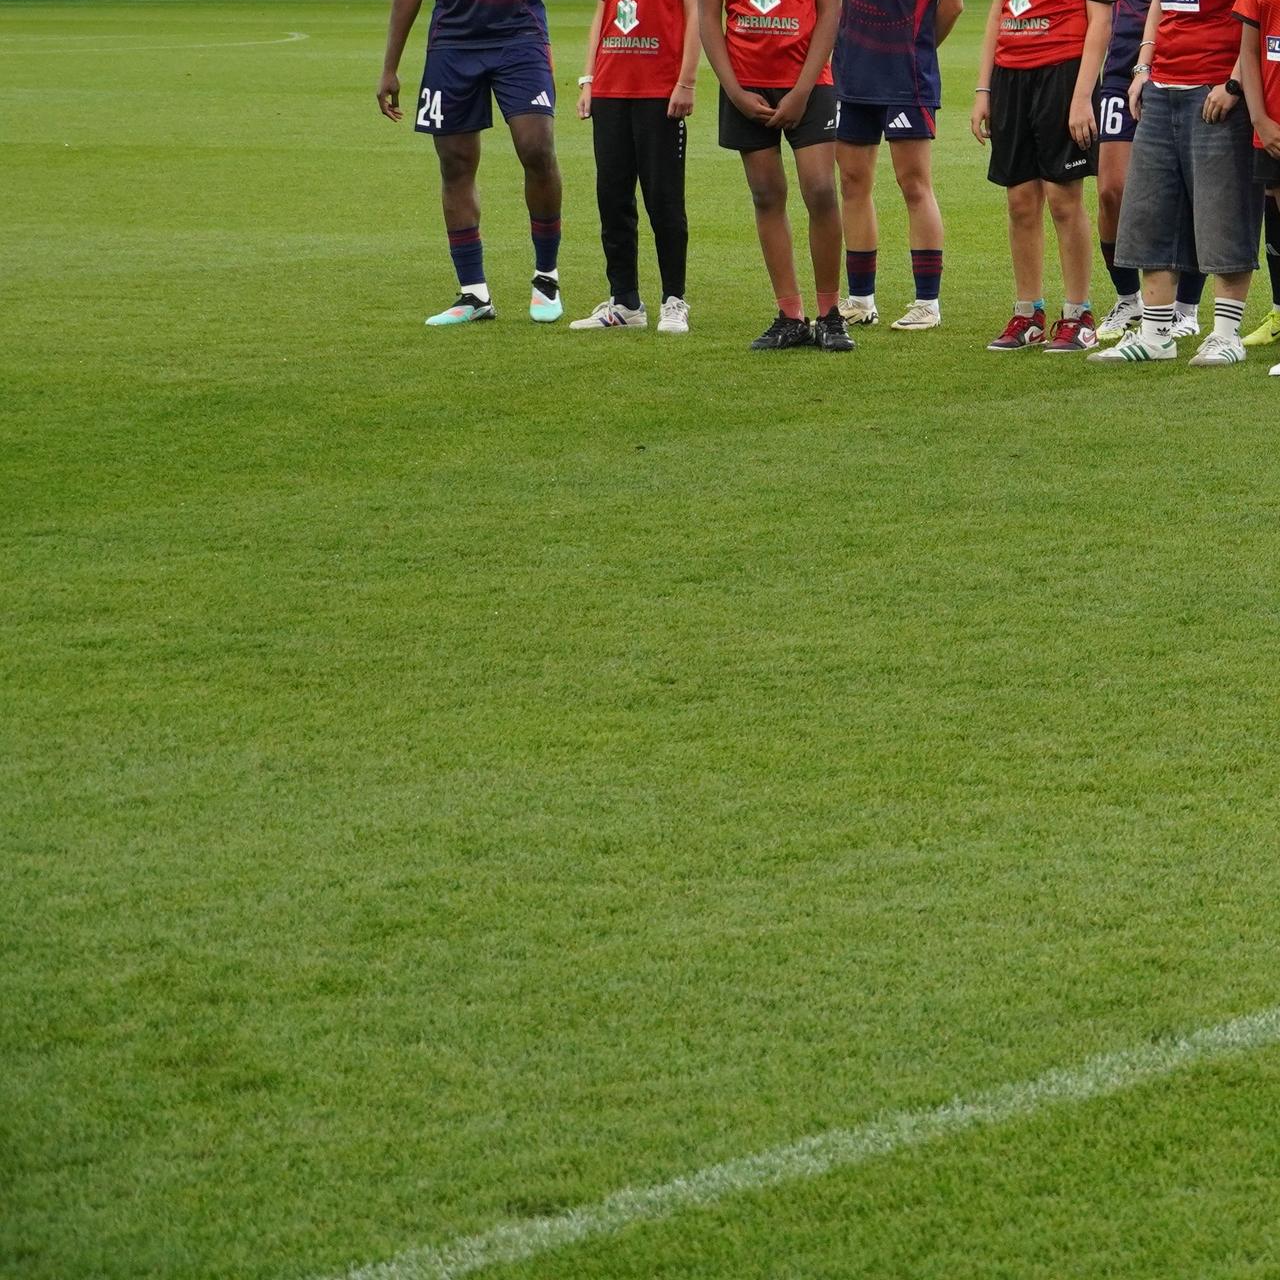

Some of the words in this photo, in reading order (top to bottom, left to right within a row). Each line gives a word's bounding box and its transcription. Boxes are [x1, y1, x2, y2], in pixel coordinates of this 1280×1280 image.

[736, 15, 800, 30] HERMANS
[602, 35, 660, 50] HERMANS
[416, 87, 444, 129] 24
[1071, 158, 1087, 168] JAKO
